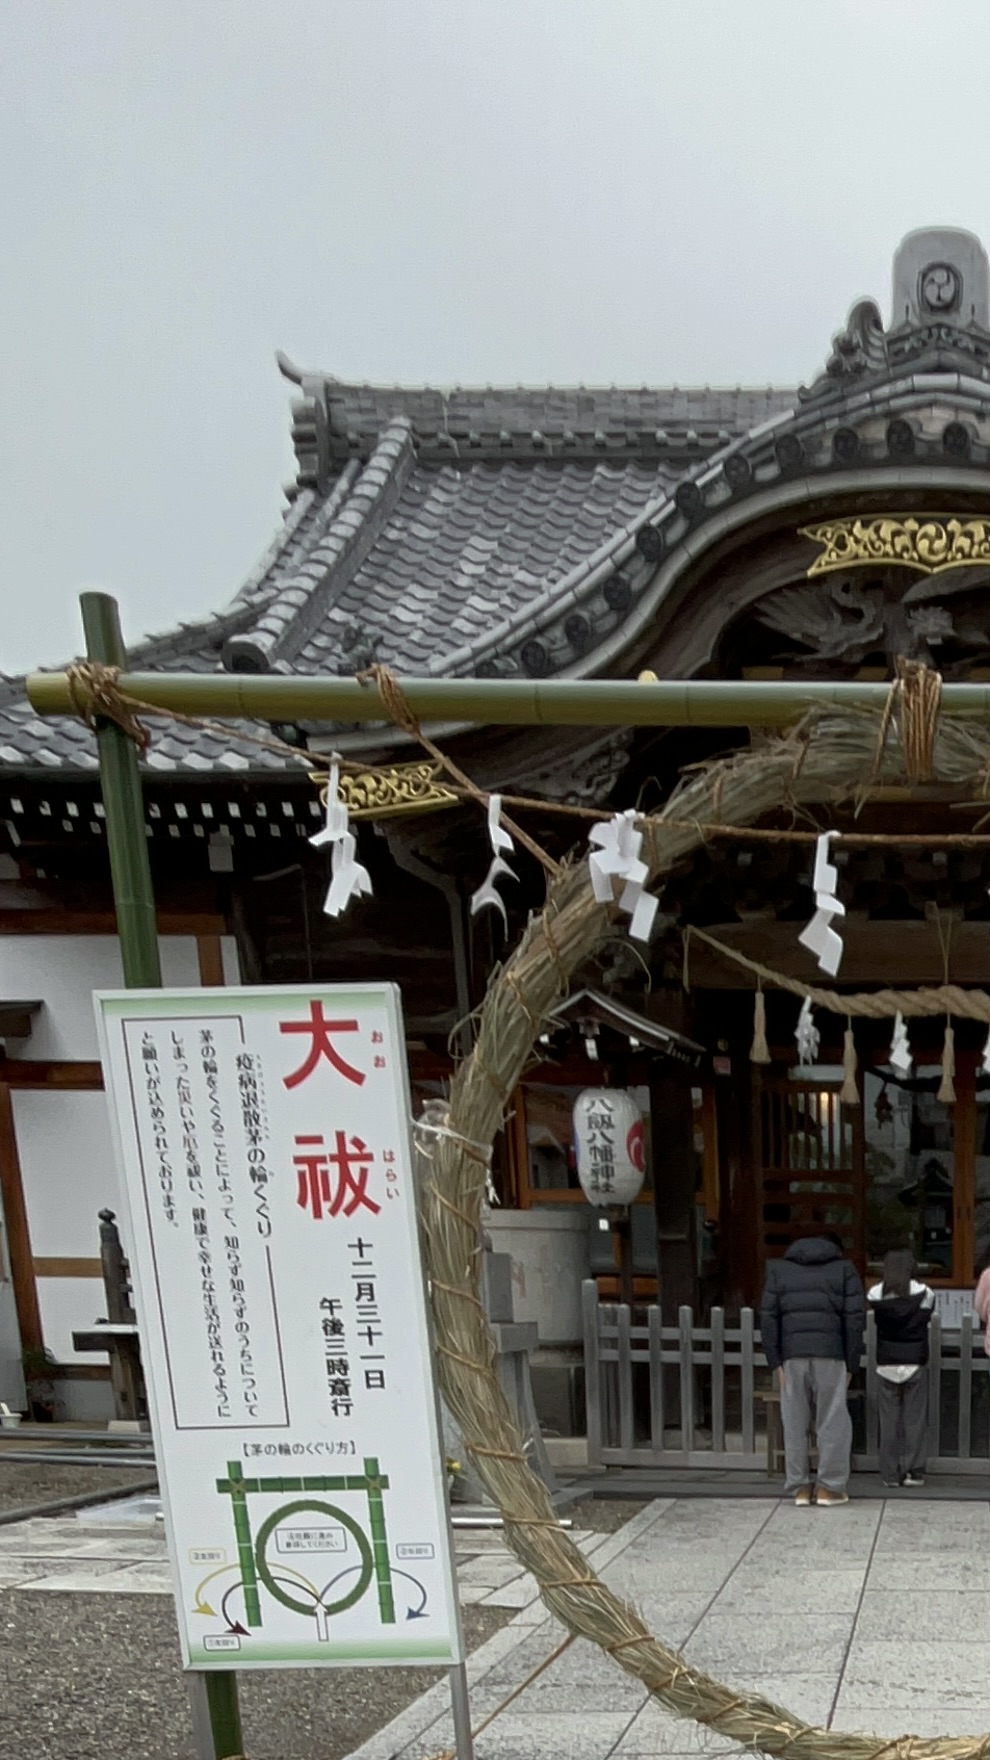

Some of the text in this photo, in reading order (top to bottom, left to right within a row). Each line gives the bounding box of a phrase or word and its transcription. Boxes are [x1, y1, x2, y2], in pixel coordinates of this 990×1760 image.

[371, 1030, 386, 1068] おお
[279, 1000, 381, 1220] 大祓
[383, 1150, 400, 1199] はらい
[347, 1237, 386, 1390] 十二月三十一日
